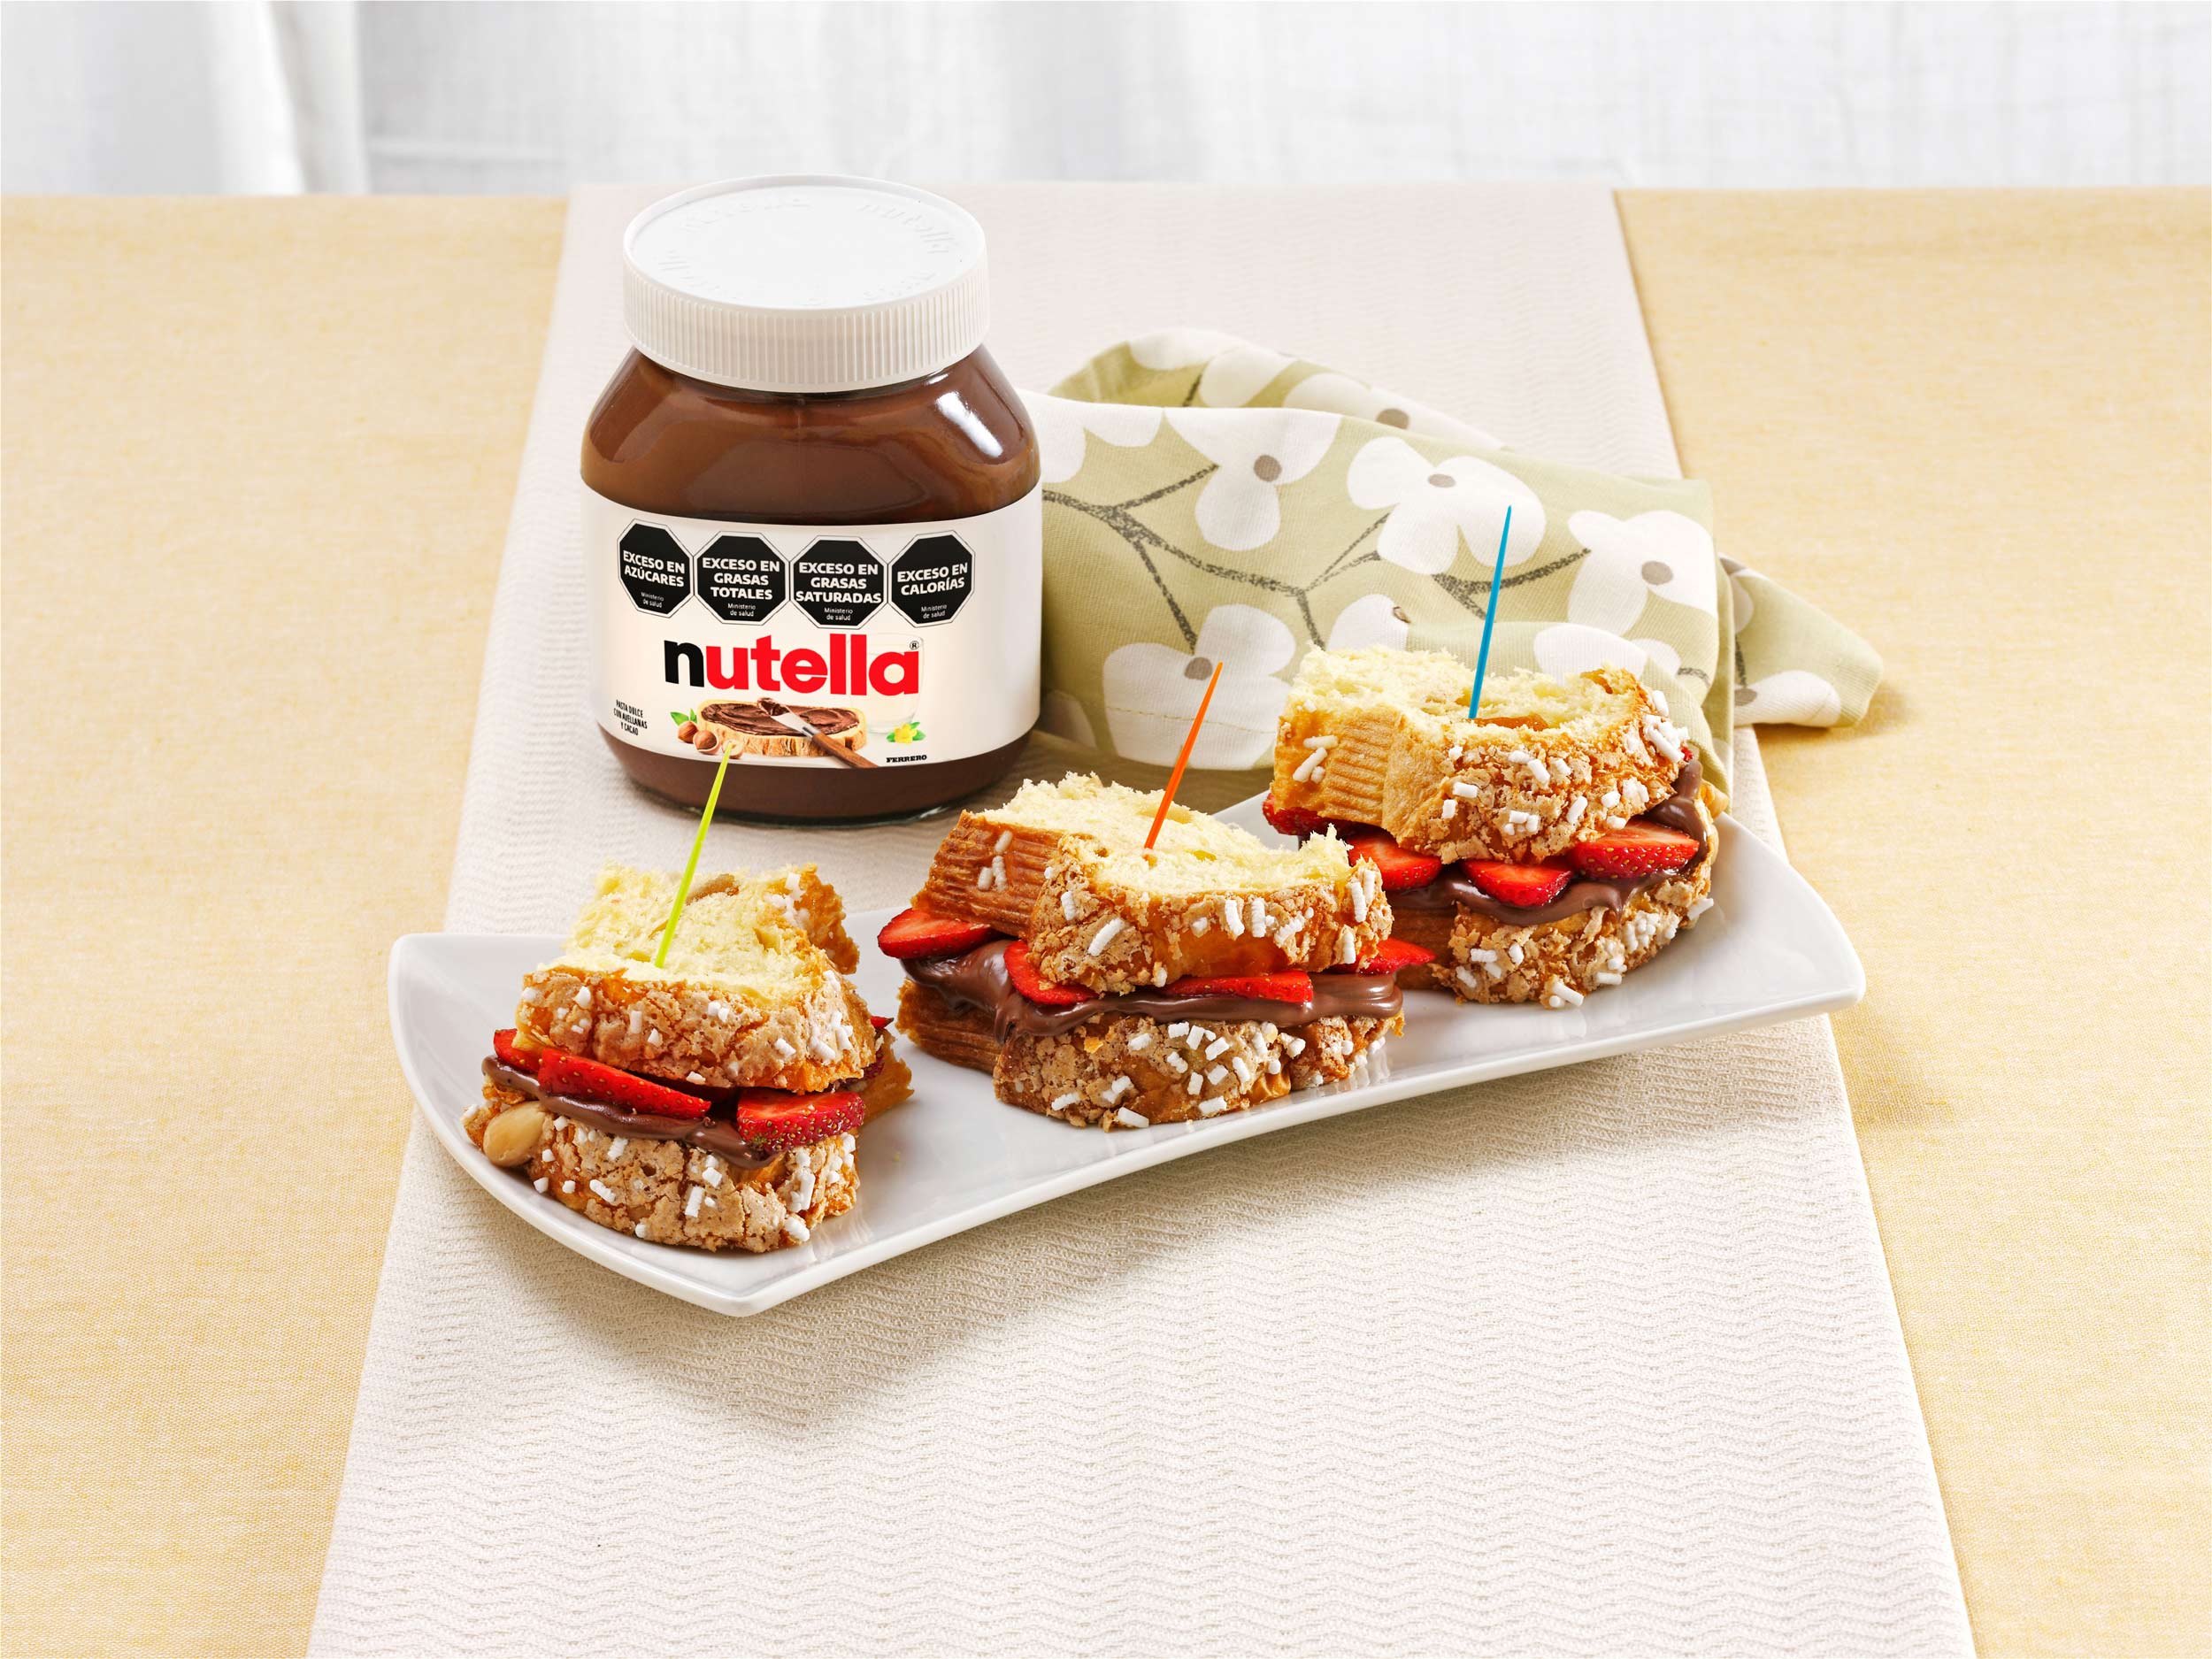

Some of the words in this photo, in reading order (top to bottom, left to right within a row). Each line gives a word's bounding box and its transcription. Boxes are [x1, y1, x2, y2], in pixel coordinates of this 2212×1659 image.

[623, 550, 664, 571] EXCESO
[666, 561, 686, 574] EN
[702, 557, 757, 572] EXCESO
[760, 560, 780, 572] EN
[799, 562, 855, 575] EXCESO
[857, 564, 879, 575] EN
[624, 565, 685, 588] AZÚCARES
[713, 572, 769, 586] GRASAS
[897, 566, 949, 583] EXCESO
[951, 563, 969, 575] EN
[810, 577, 867, 589] GRASAS
[901, 577, 965, 596] CALORÍAS
[641, 591, 664, 602] Ministerio
[710, 587, 773, 600] TOTALES
[795, 590, 882, 604] SATURADAS
[649, 599, 663, 609] salud
[921, 603, 948, 612] Ministerio
[664, 633, 919, 696] nutella
[886, 754, 927, 763] FERRERO
